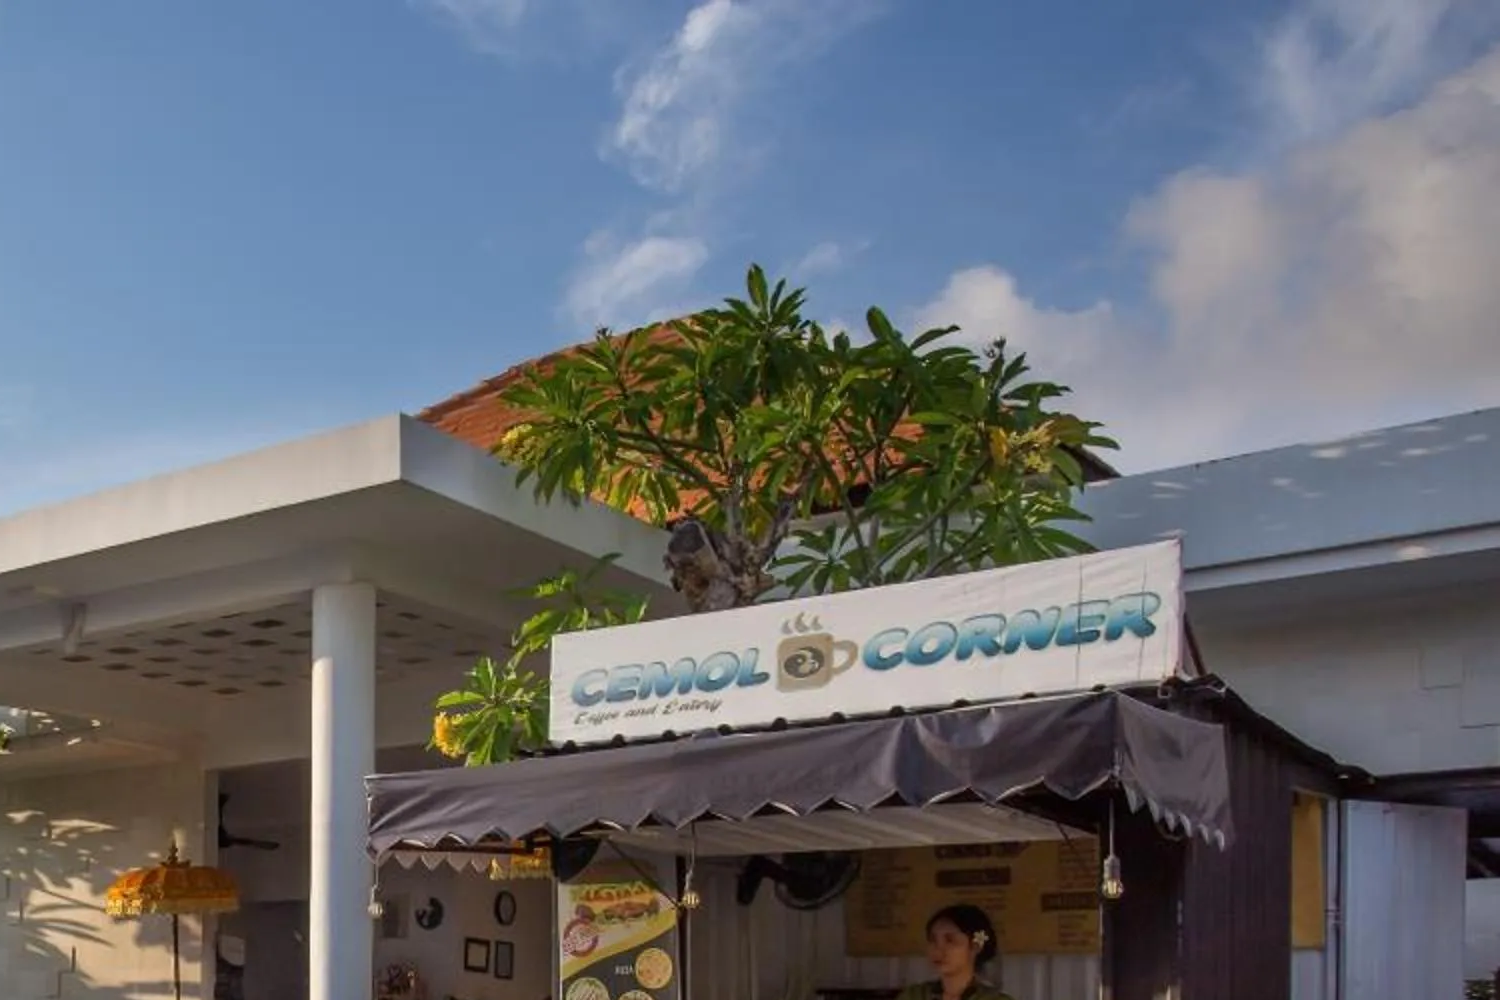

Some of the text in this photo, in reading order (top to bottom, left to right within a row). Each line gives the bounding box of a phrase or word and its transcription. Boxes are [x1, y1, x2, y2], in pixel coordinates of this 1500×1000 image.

[571, 591, 1162, 706] CEMOL CORNER
[623, 702, 659, 718] and
